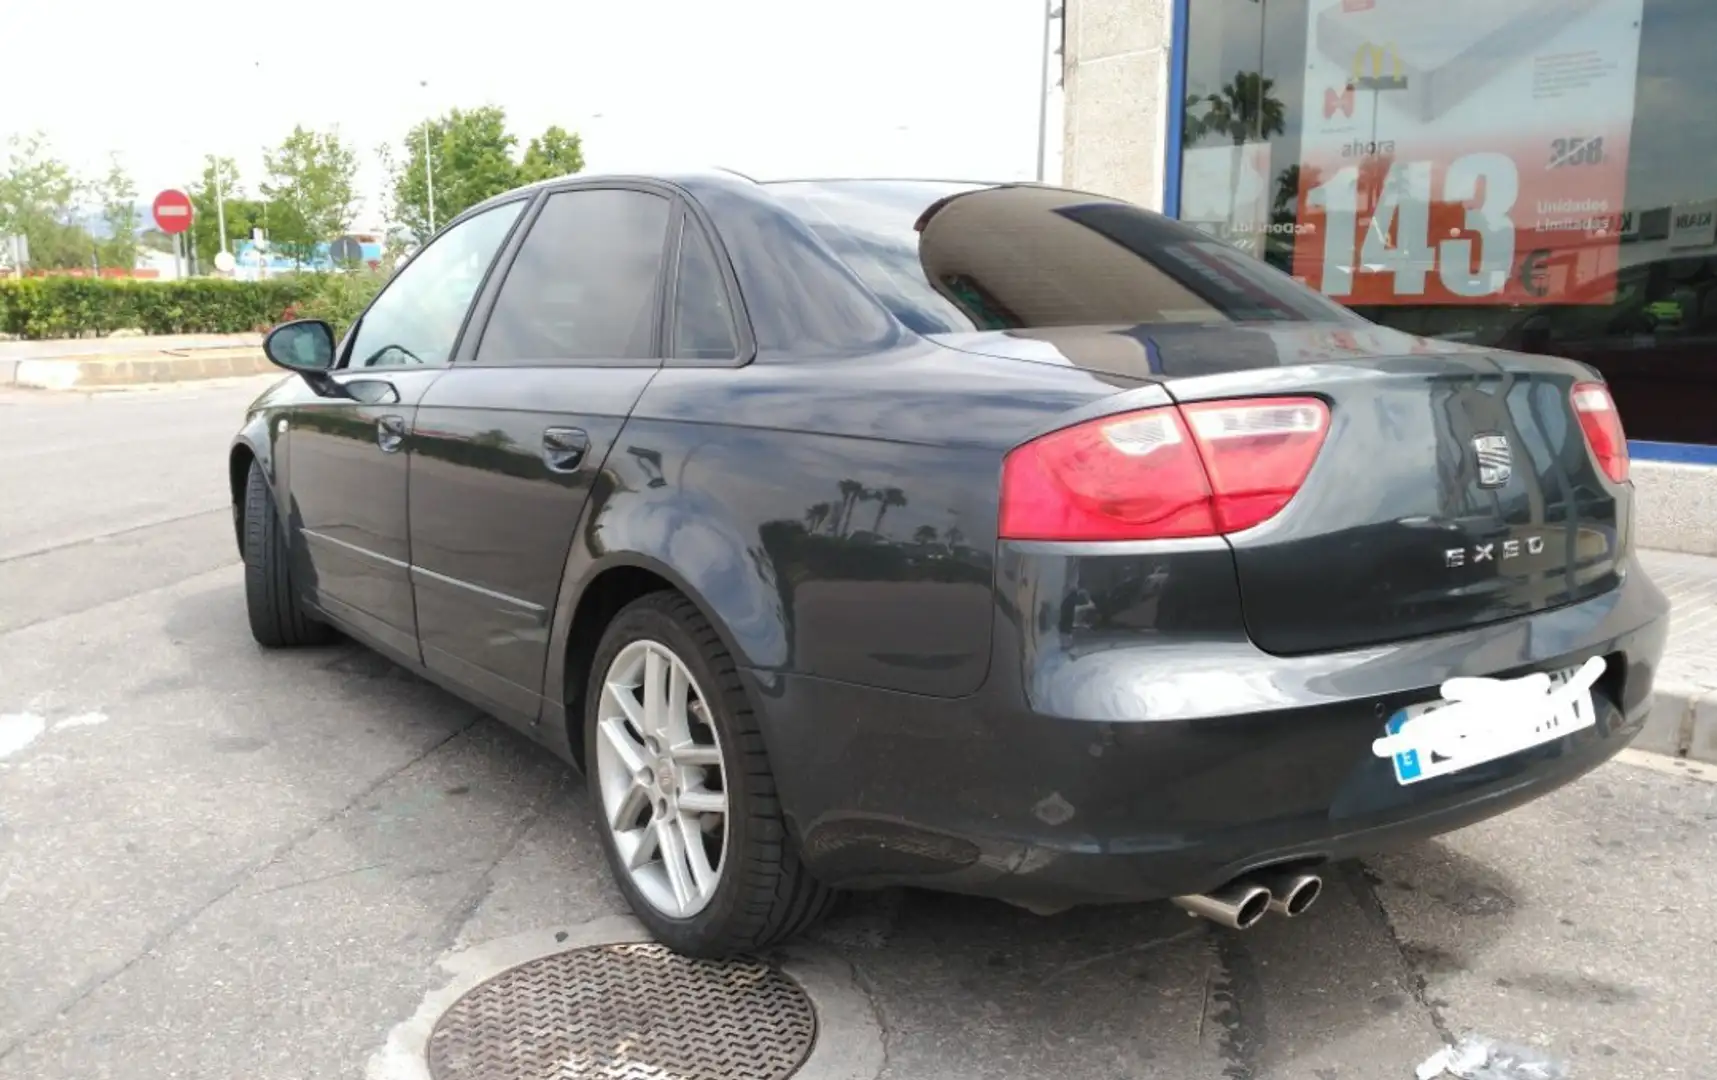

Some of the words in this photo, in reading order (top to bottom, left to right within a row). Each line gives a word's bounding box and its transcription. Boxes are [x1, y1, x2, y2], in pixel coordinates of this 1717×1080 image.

[1342, 137, 1395, 158] ahora
[1536, 196, 1608, 214] Unidades
[1305, 152, 1519, 296] 143
[1535, 214, 1608, 232] Limitadas
